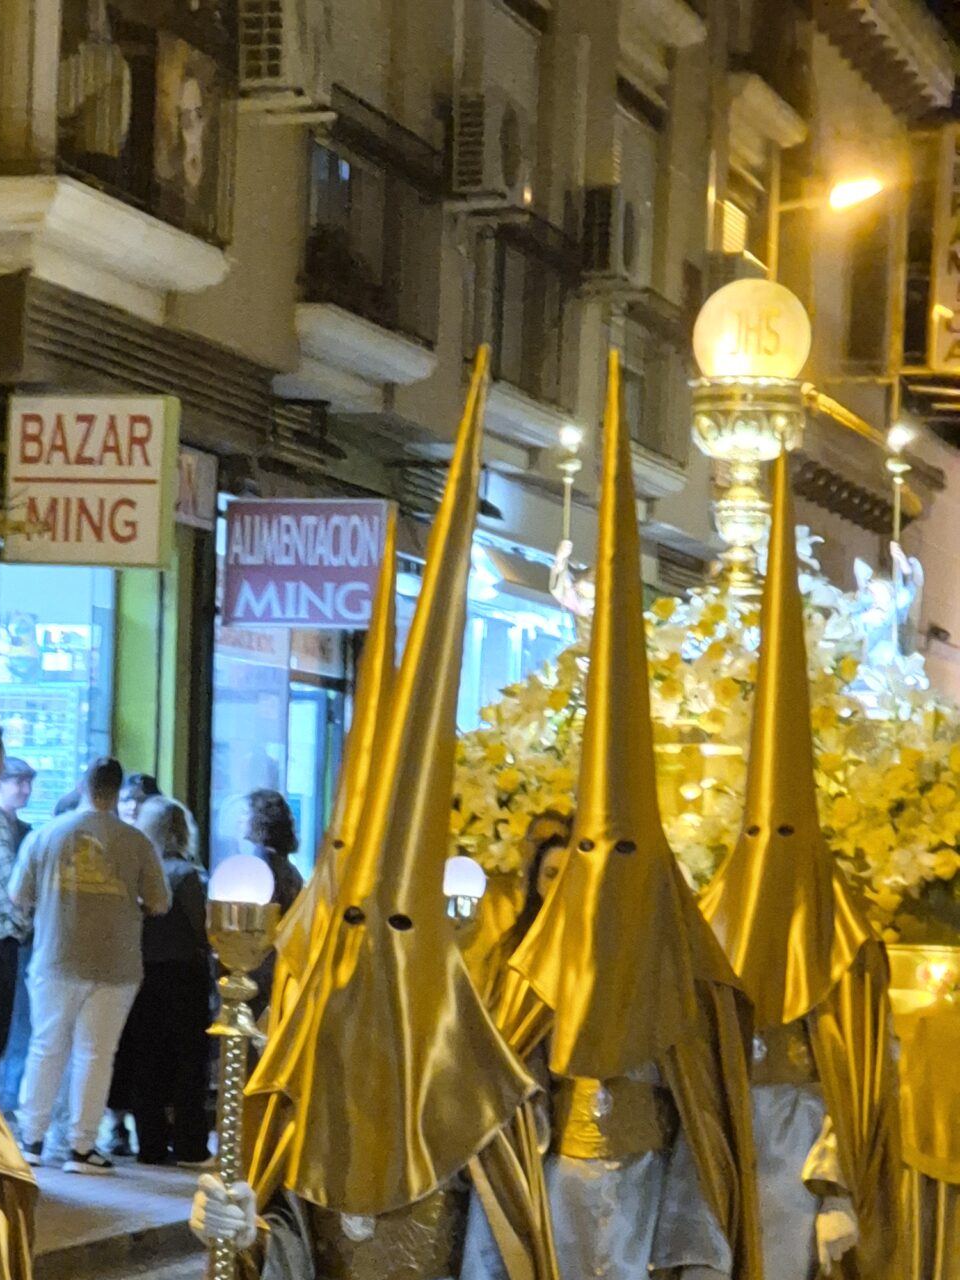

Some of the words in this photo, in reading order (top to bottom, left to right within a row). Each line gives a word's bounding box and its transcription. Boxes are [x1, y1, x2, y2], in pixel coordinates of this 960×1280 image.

[20, 413, 153, 466] BAZAR
[25, 496, 139, 544] MING
[228, 513, 381, 567] ALIMENTACION
[233, 579, 372, 621] MING
